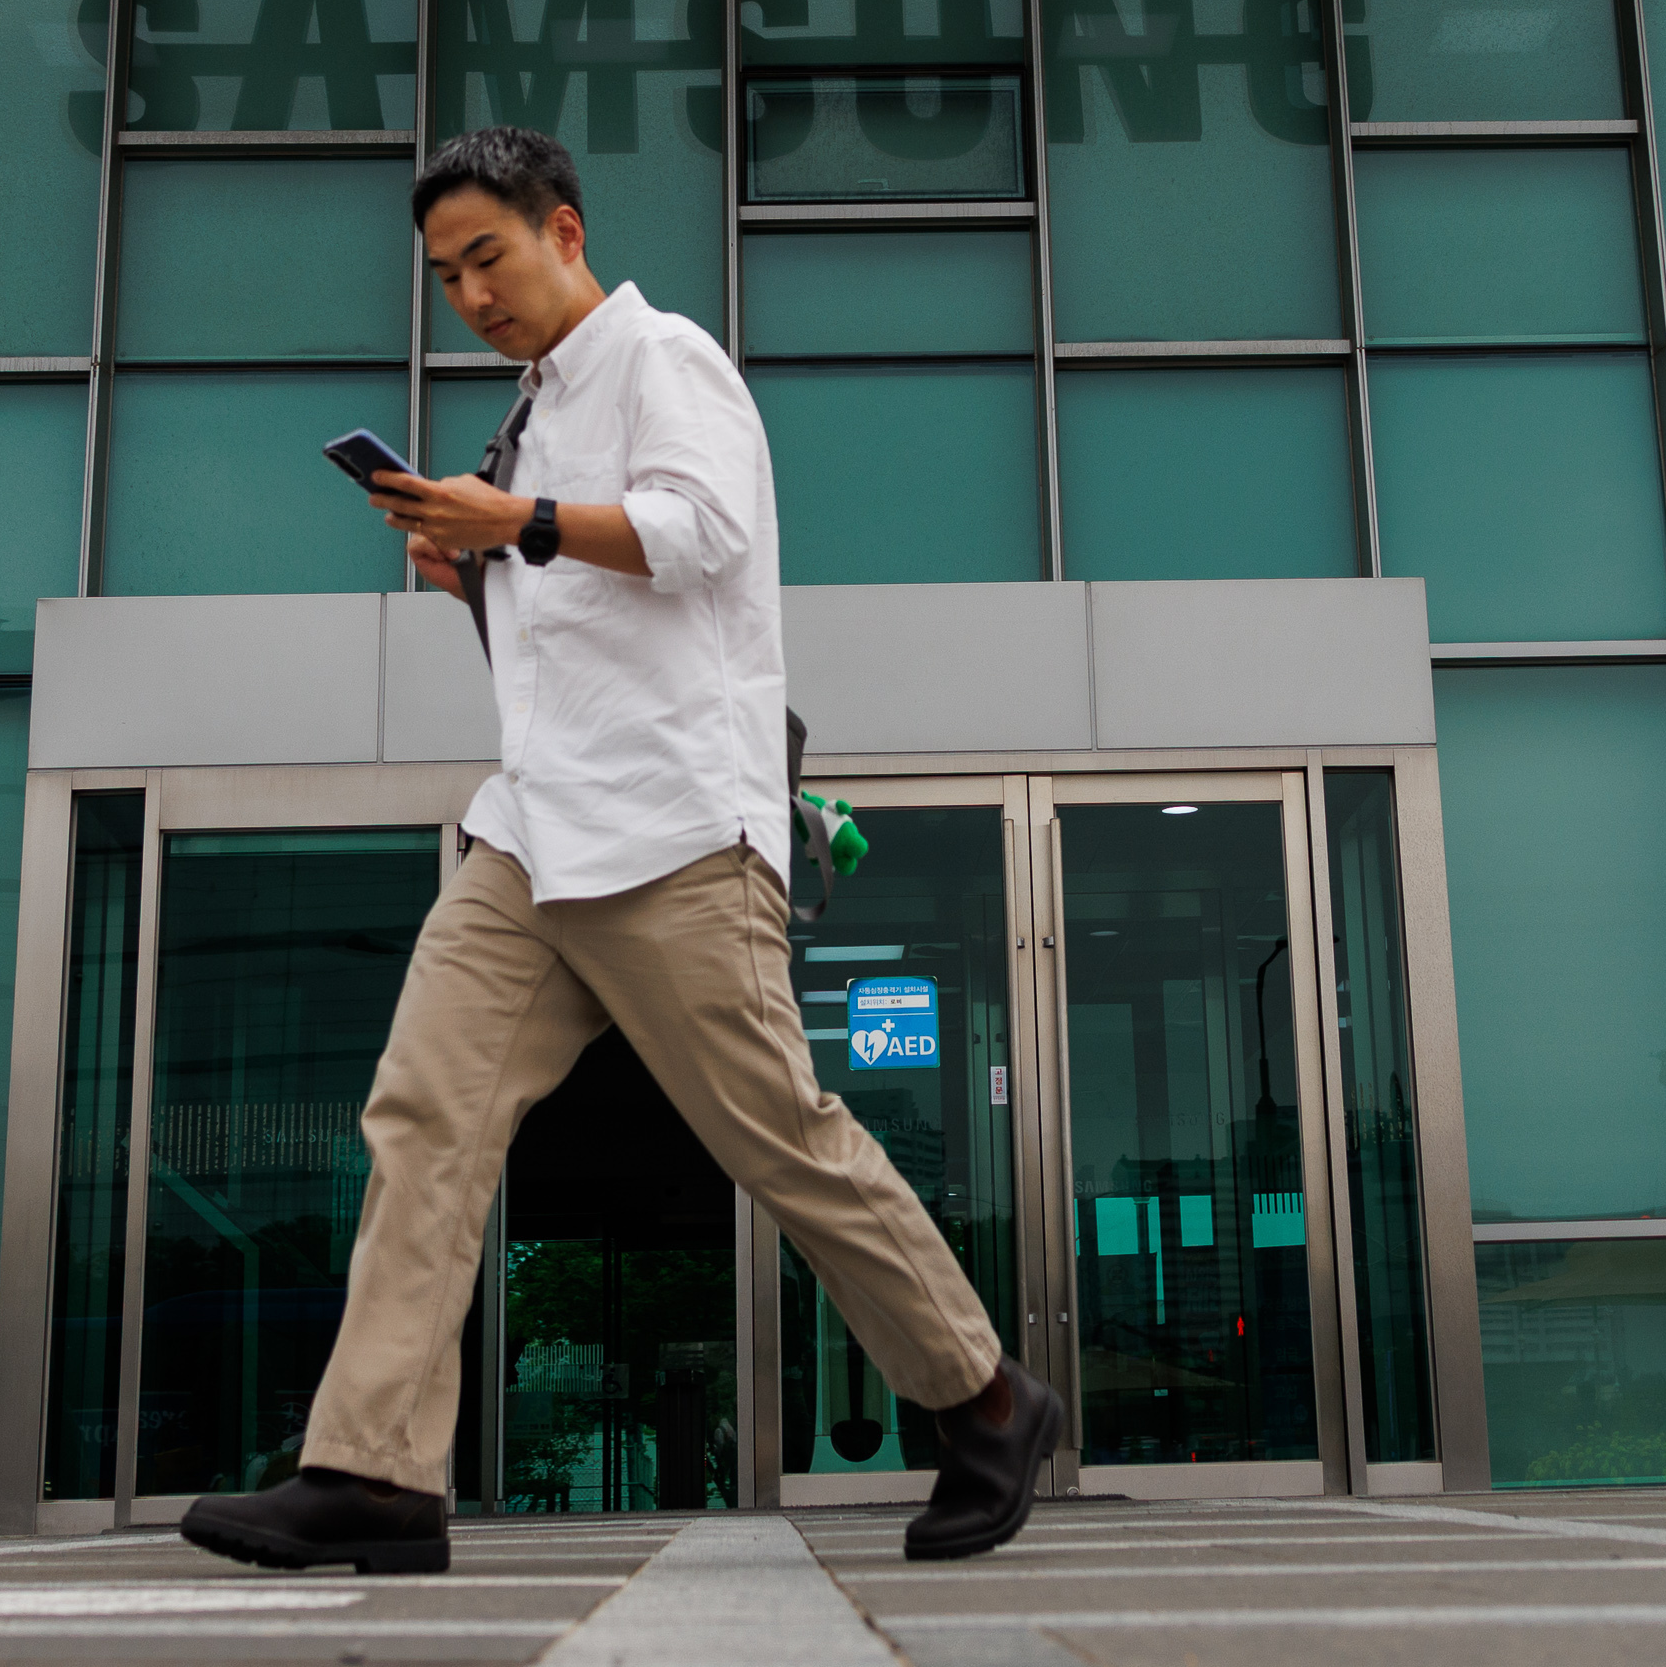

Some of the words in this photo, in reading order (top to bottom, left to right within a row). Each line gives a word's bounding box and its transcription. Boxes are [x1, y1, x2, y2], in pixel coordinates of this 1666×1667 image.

[858, 986, 902, 994] 자동심장충격기
[904, 985, 929, 994] 설치시설
[887, 1035, 936, 1057] AED
